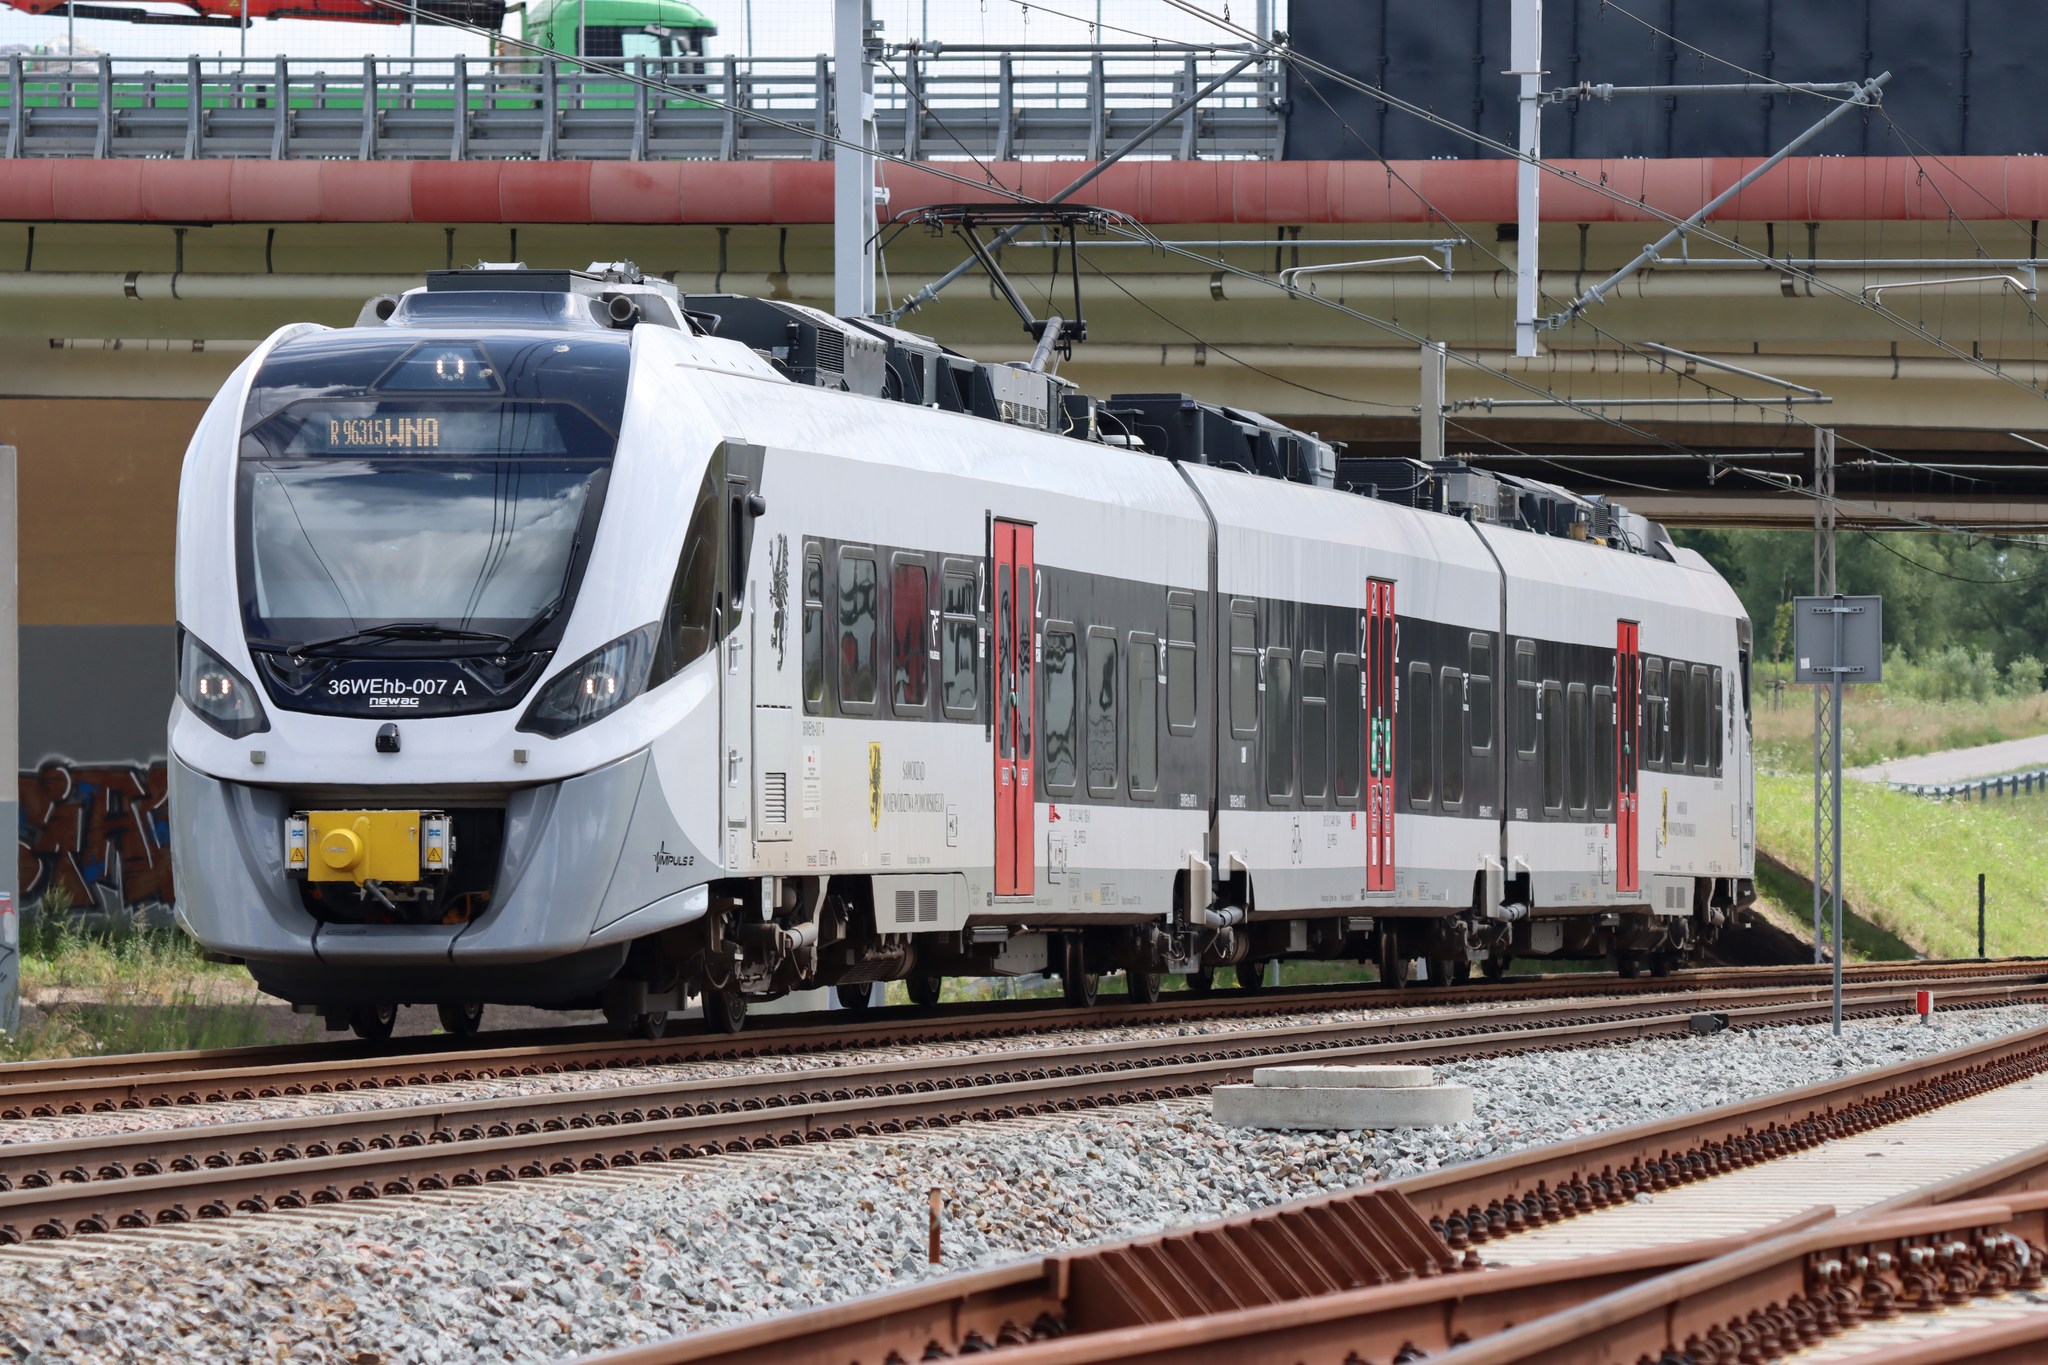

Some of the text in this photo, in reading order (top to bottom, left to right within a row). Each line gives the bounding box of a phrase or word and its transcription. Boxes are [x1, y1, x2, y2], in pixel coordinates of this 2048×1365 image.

[330, 418, 439, 447] R 96315 WNA
[978, 561, 986, 613] 2
[1035, 568, 1042, 619] 2
[1360, 615, 1367, 660] 2
[328, 678, 468, 696] 36WEhb-007 A
[688, 855, 695, 867] 2
